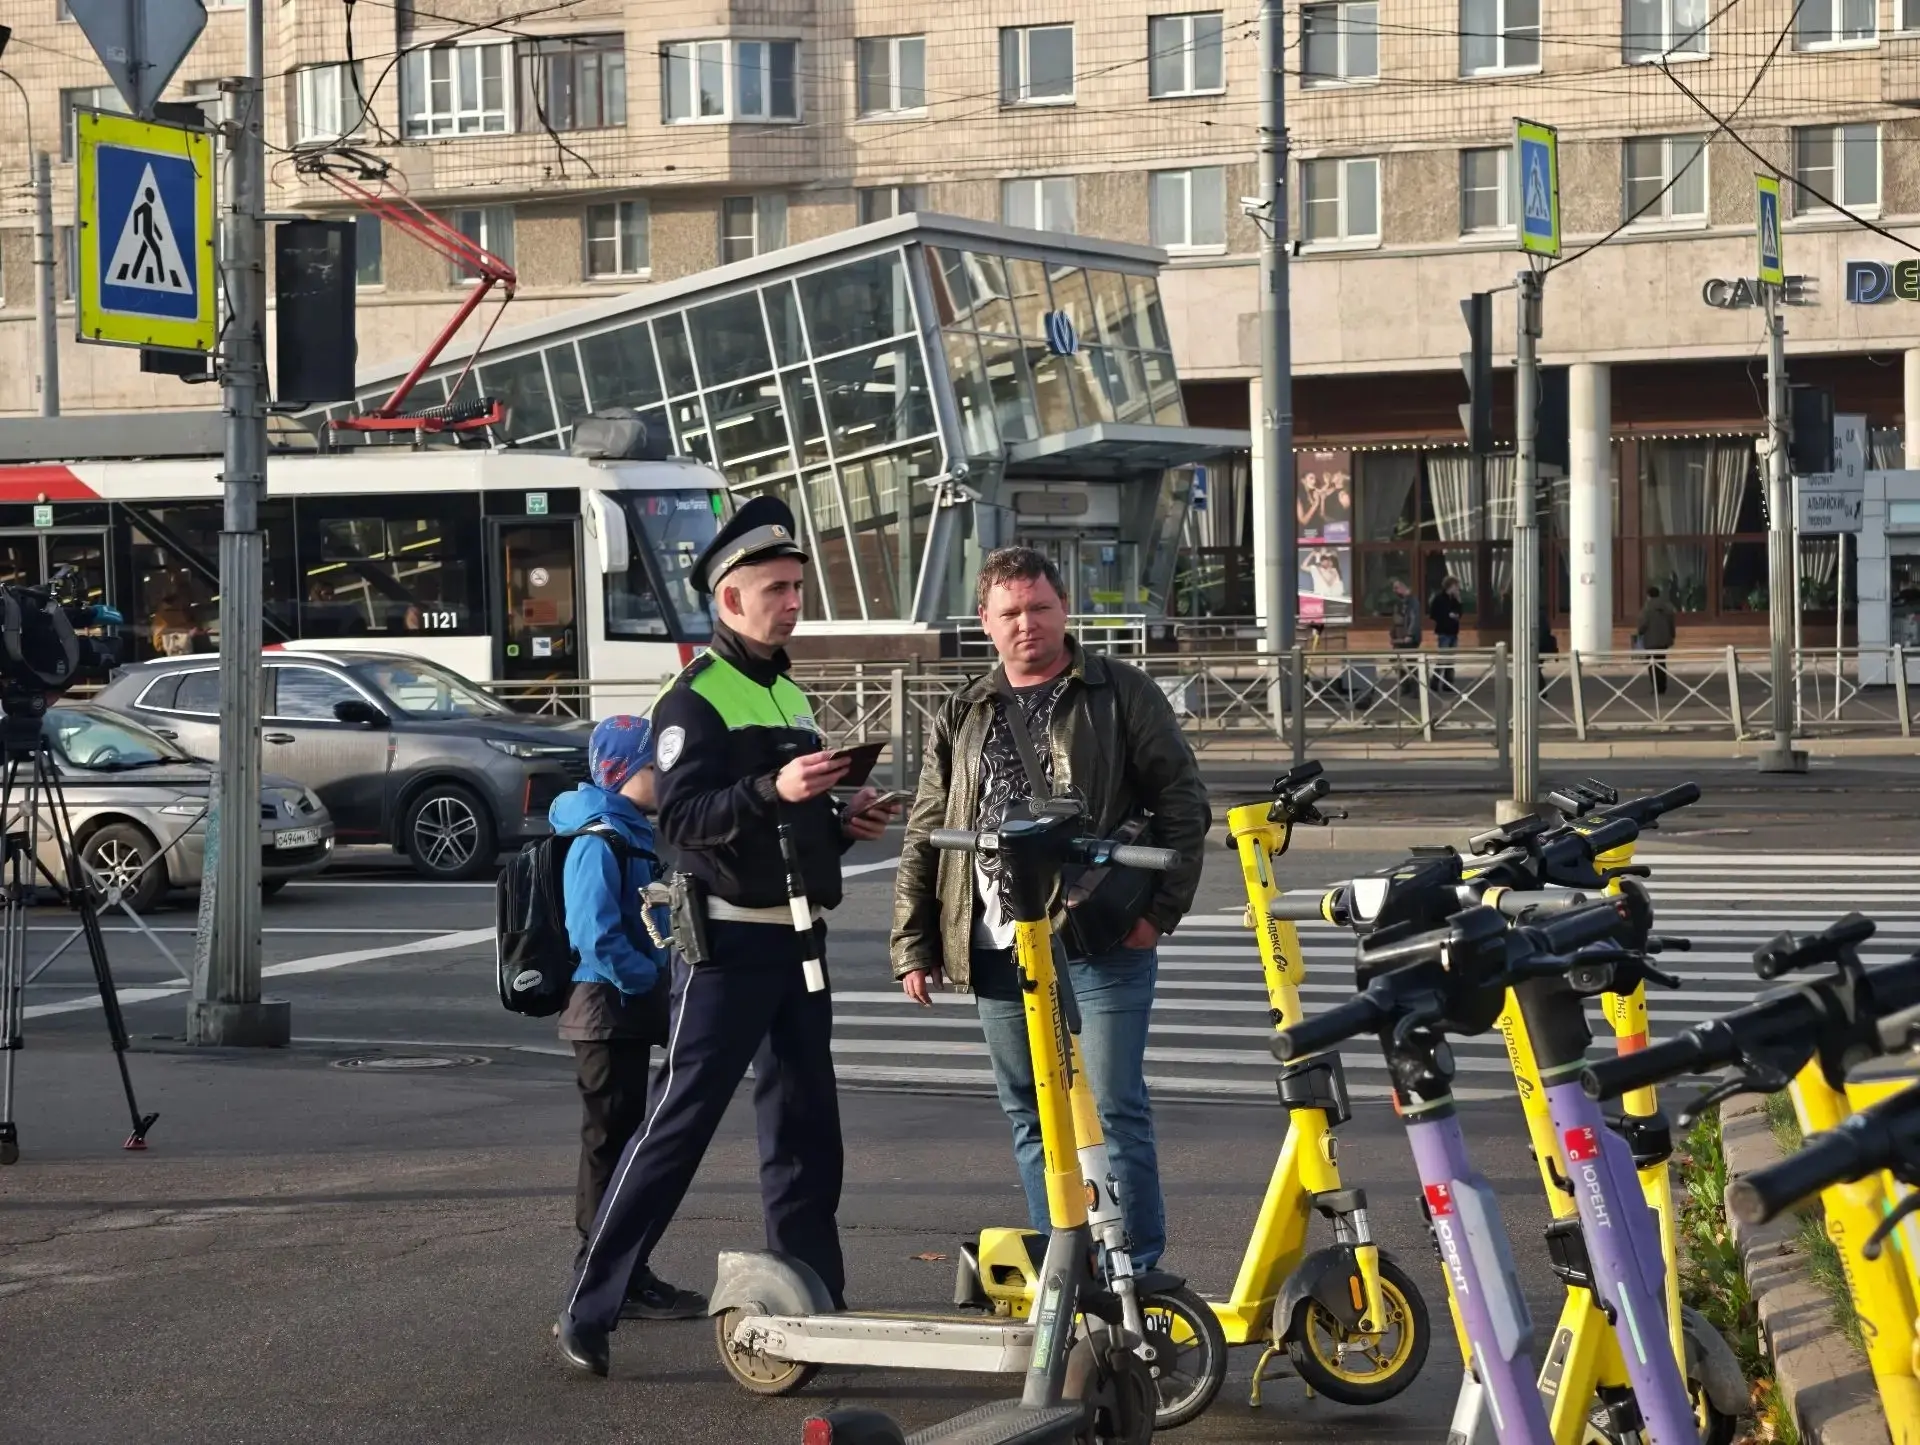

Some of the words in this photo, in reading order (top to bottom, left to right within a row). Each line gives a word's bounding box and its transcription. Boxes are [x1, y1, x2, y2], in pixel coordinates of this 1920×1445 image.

[1702, 275, 1807, 308] CAE
[422, 611, 458, 629] 1121
[1048, 982, 1067, 1069] WHOOSH
[1501, 1015, 1524, 1073] Яндекс
[1582, 1164, 1612, 1229] ЮРЕНТ
[1438, 1218, 1469, 1294] ЮРЕНТ
